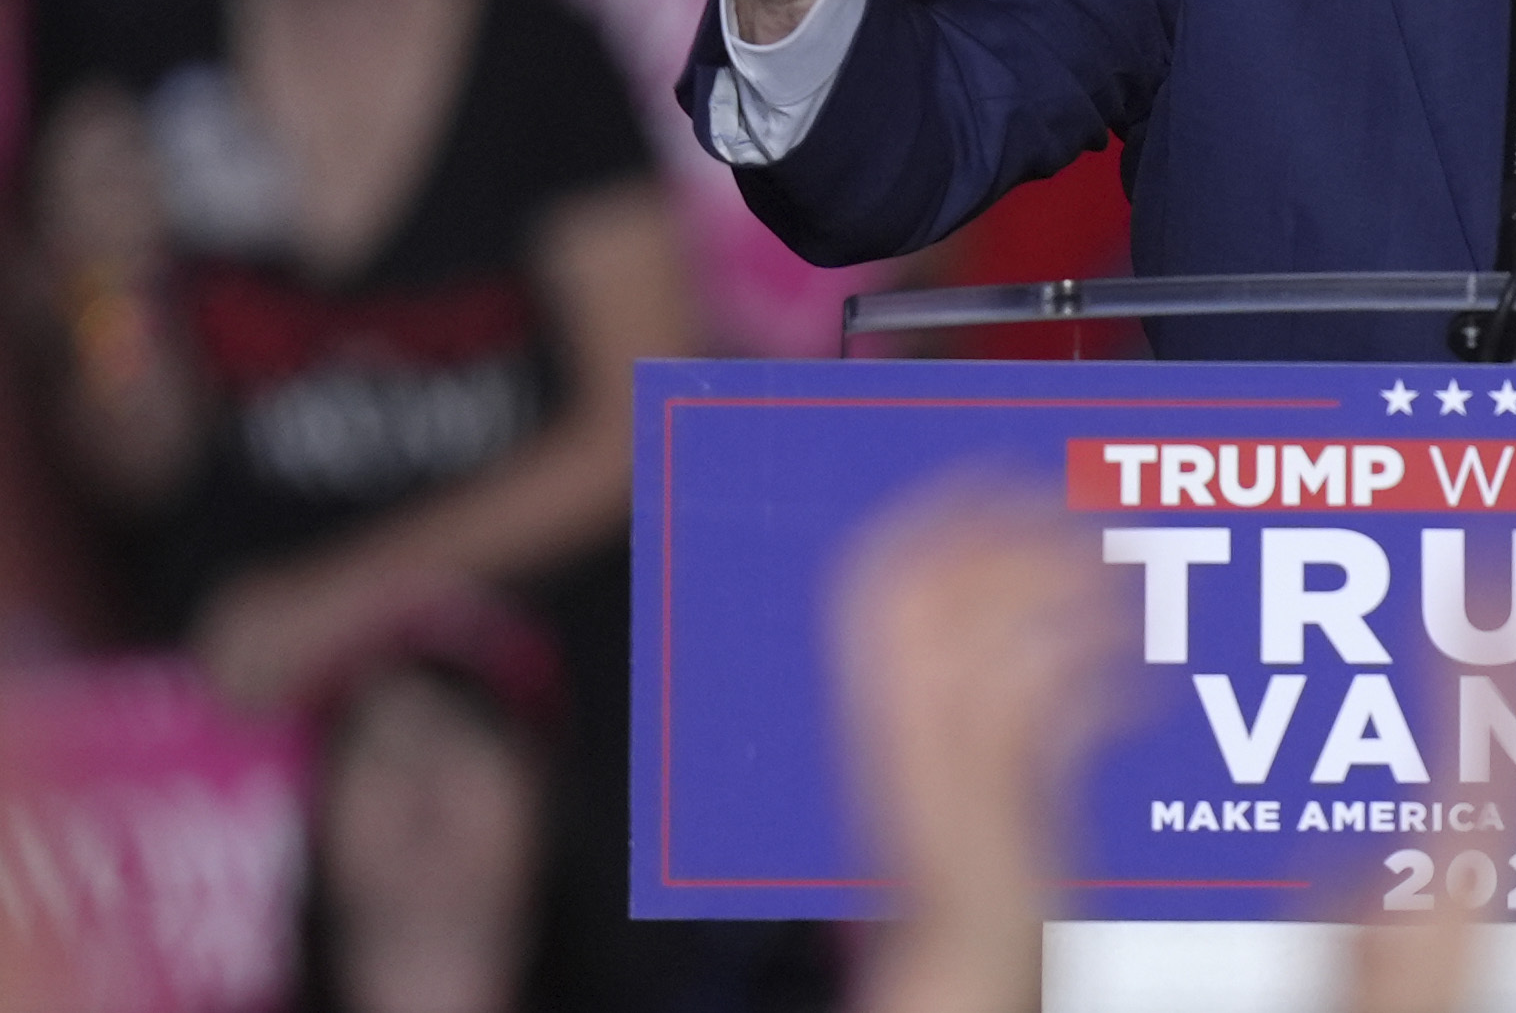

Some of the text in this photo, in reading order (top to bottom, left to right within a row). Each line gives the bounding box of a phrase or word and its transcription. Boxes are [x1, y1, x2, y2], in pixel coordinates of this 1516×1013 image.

[1103, 443, 1406, 508] TRUMP
[1150, 799, 1282, 833] MAKE
[1295, 799, 1507, 834] AMERICA
